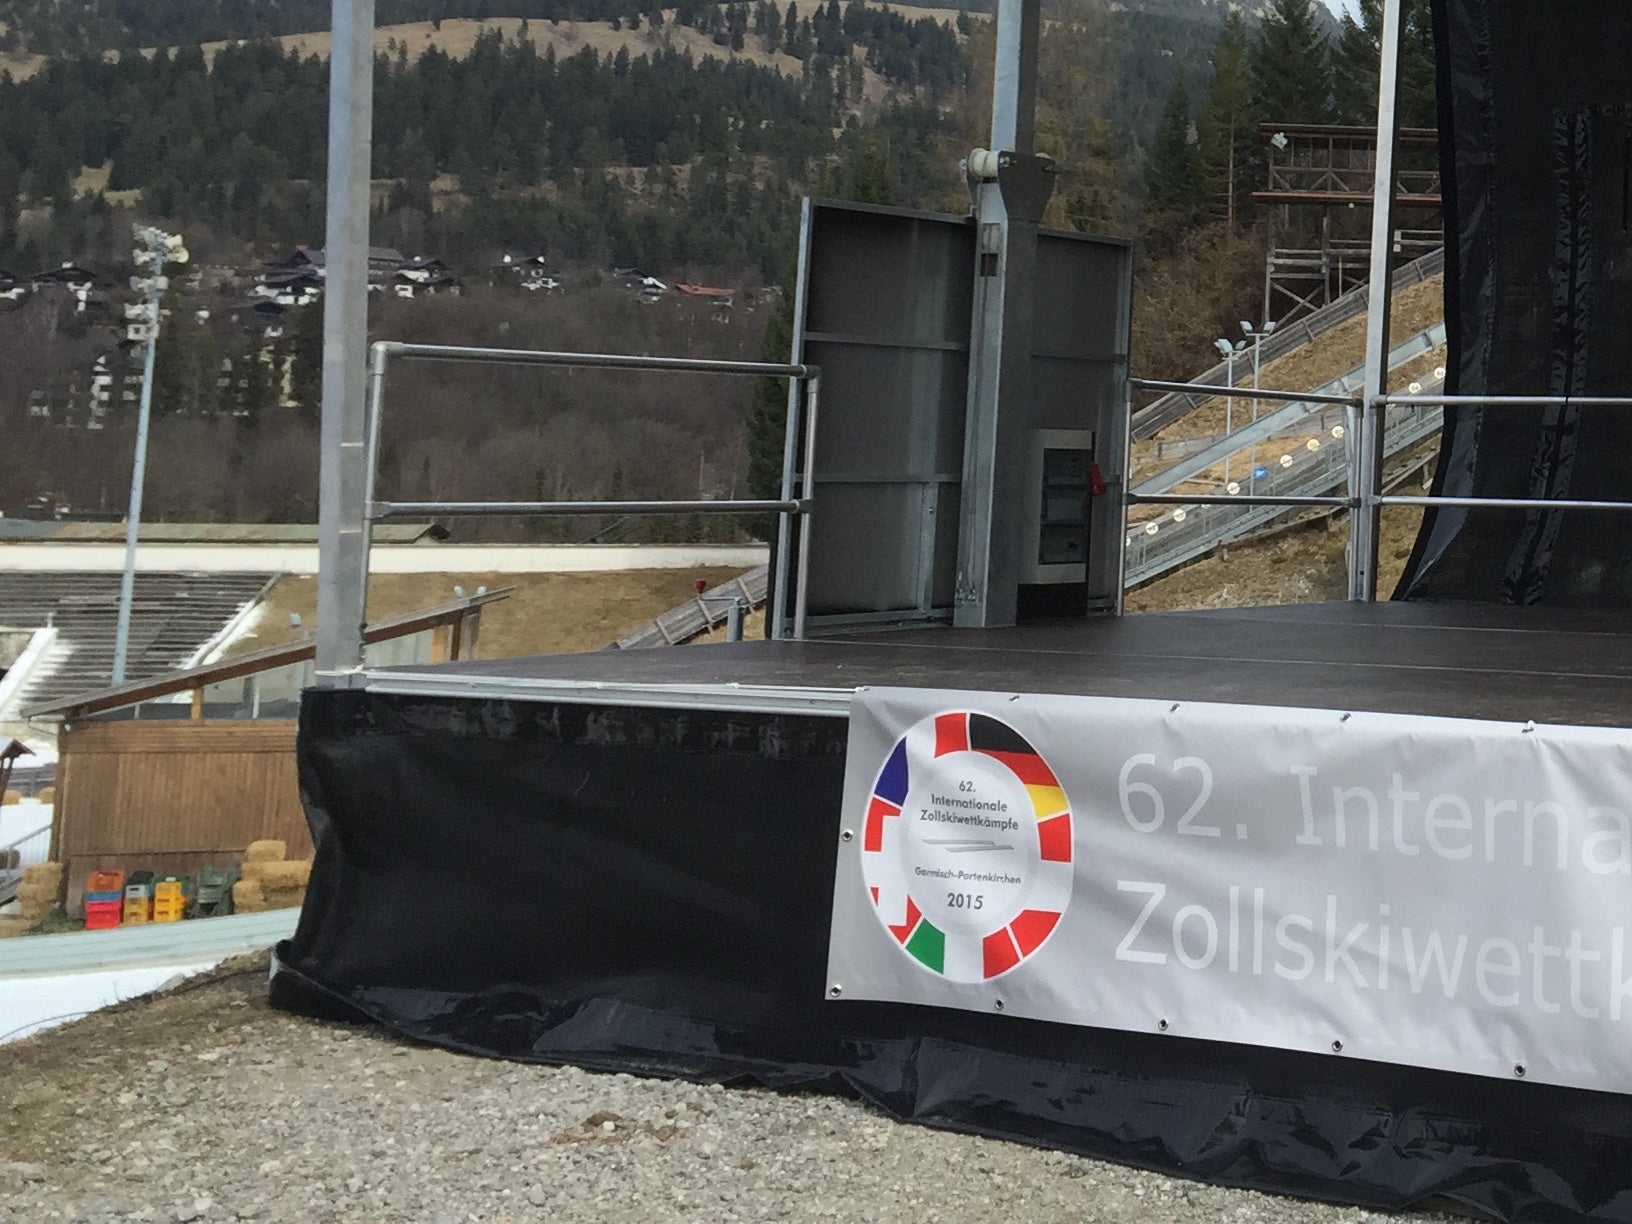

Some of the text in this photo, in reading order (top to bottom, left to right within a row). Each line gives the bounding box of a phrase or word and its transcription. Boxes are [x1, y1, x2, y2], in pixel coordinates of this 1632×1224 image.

[959, 780, 976, 793] 62.
[931, 794, 1008, 812] Internationale
[1117, 752, 1248, 840] 62.
[920, 809, 1019, 832] Zollskiwettkämpfe
[914, 866, 1022, 885] Garmisch-Partenkirchen
[947, 892, 984, 910] 2015
